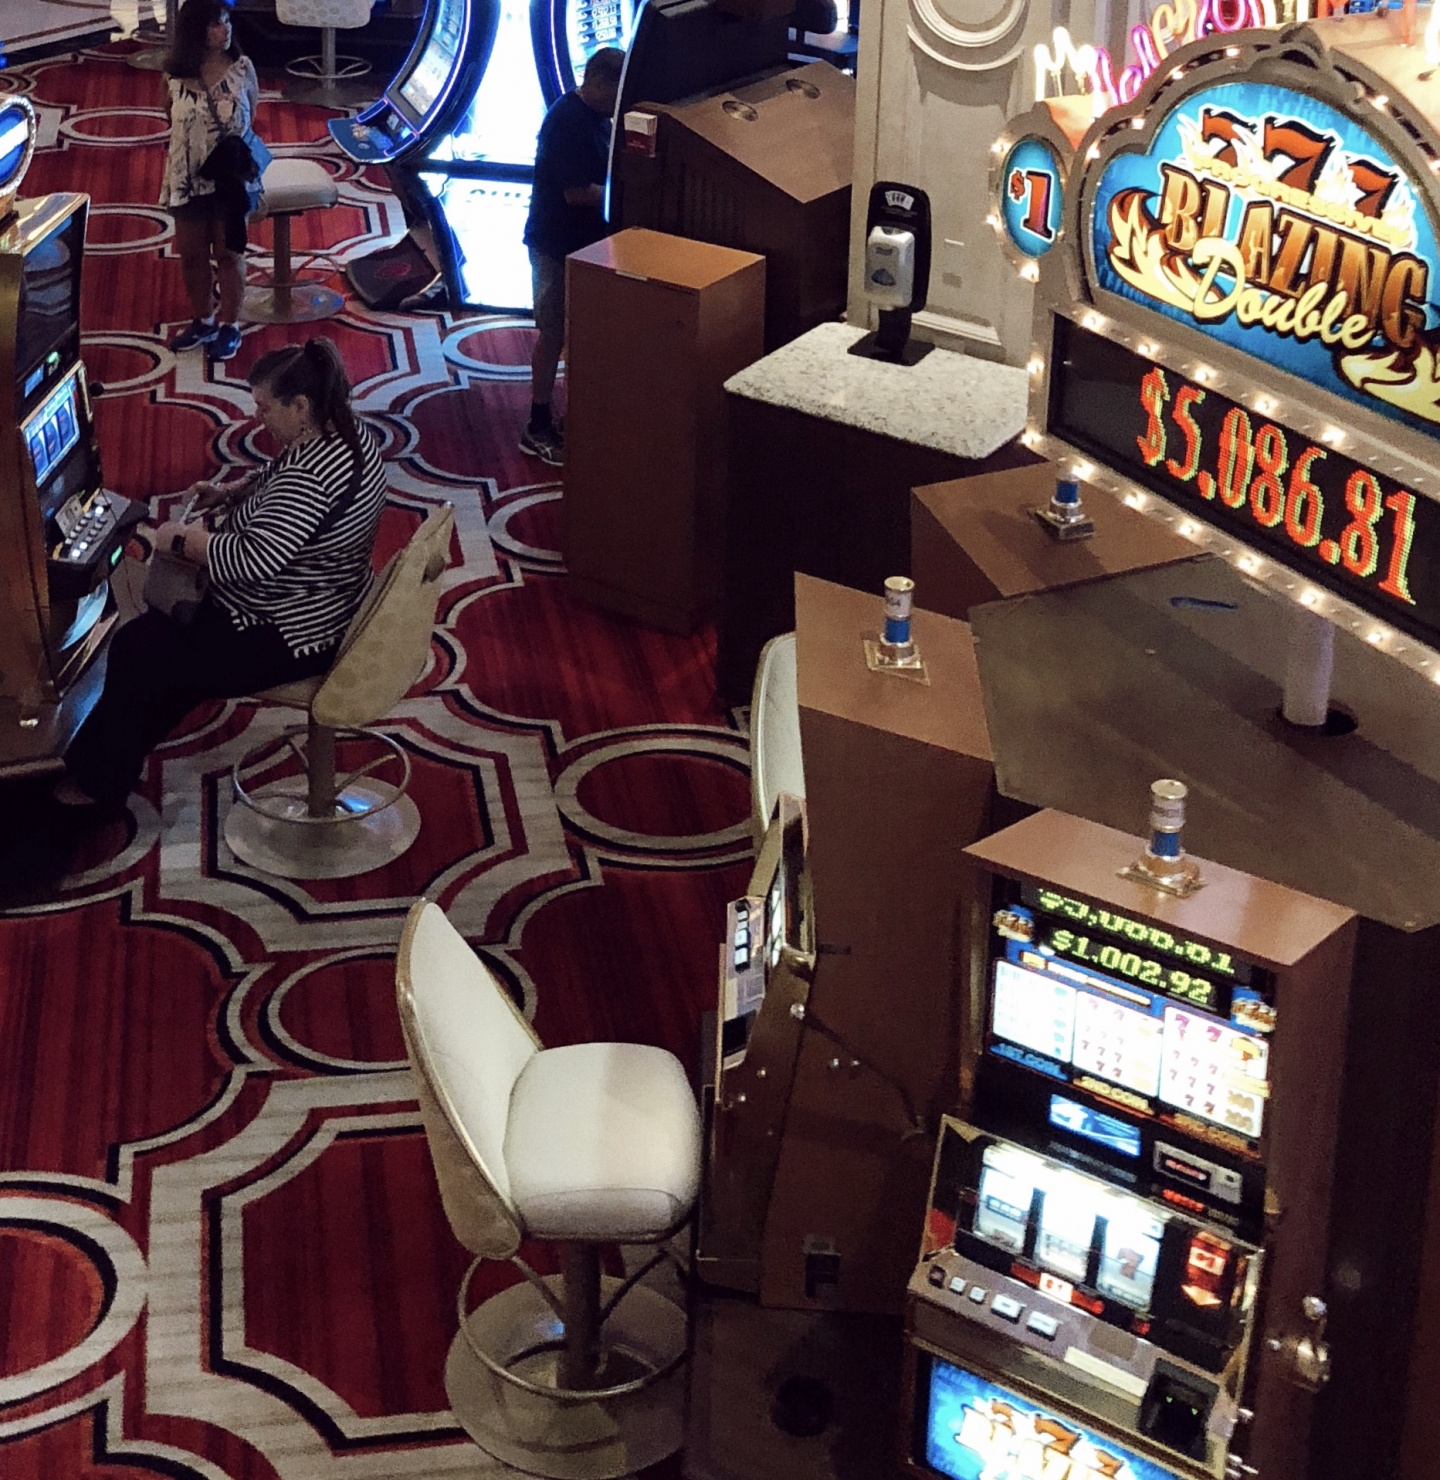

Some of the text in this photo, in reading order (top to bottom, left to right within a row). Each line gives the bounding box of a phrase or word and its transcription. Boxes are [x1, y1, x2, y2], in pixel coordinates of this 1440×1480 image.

[1008, 169, 1055, 240] $1
[1160, 161, 1428, 348] BLAZING
[1191, 236, 1373, 350] Double
